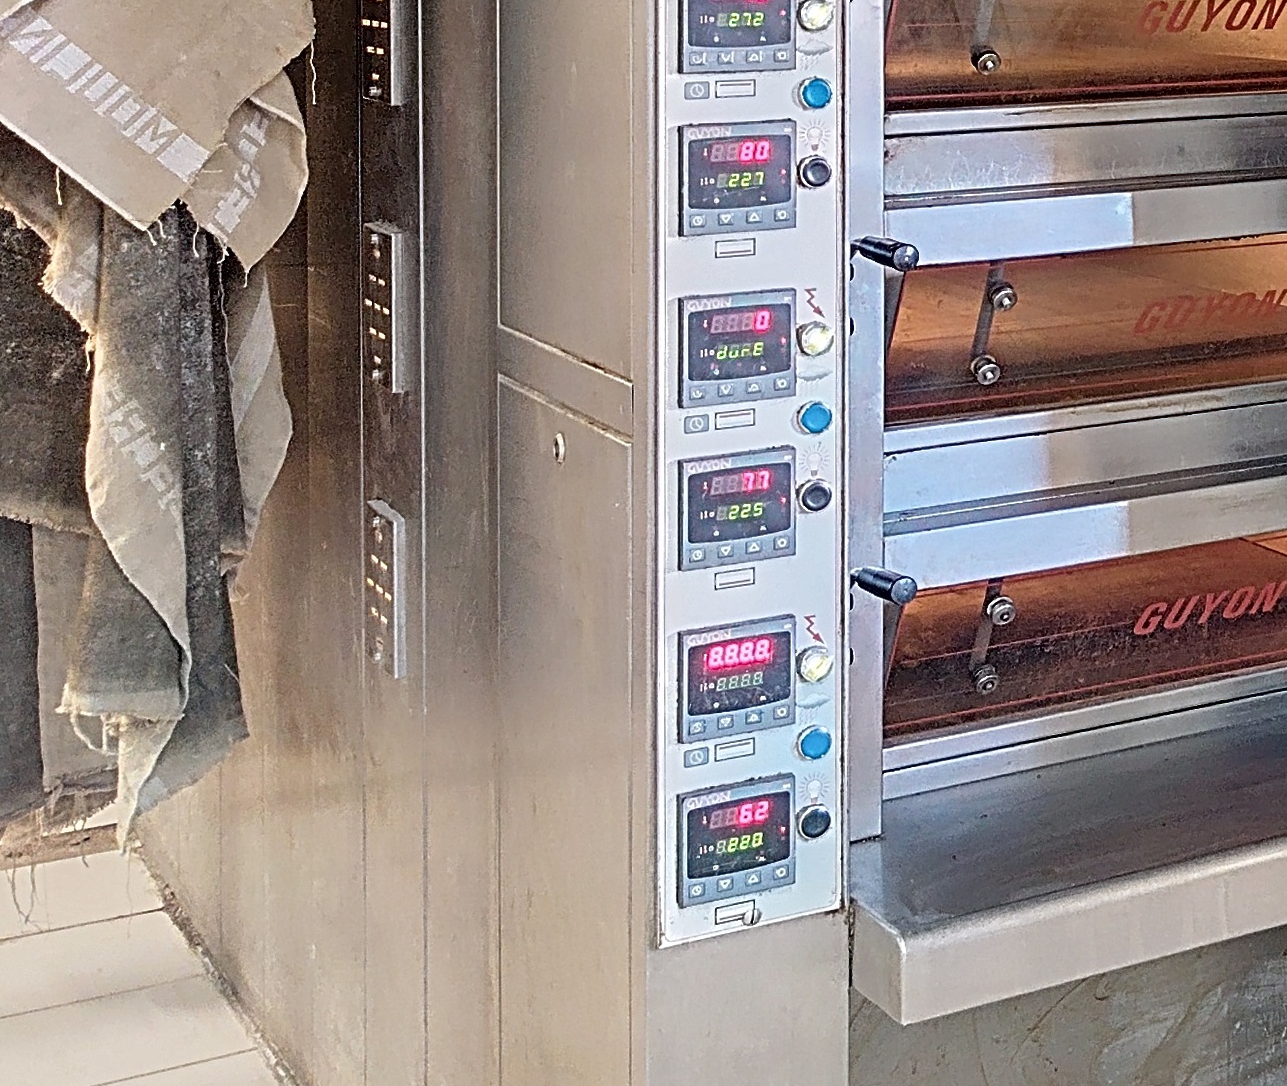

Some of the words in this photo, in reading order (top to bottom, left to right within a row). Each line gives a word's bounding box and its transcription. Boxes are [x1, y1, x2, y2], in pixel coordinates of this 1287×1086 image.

[728, 13, 764, 27] 272
[687, 126, 731, 138] GUYON
[740, 141, 770, 161] 80
[728, 171, 764, 187] 227
[687, 297, 731, 311] GUYON
[687, 458, 731, 472] GUYON
[743, 471, 770, 492] 77
[728, 501, 763, 520] 225
[688, 629, 731, 645] GUYON
[687, 791, 731, 809] GUYON
[739, 801, 769, 824] 62
